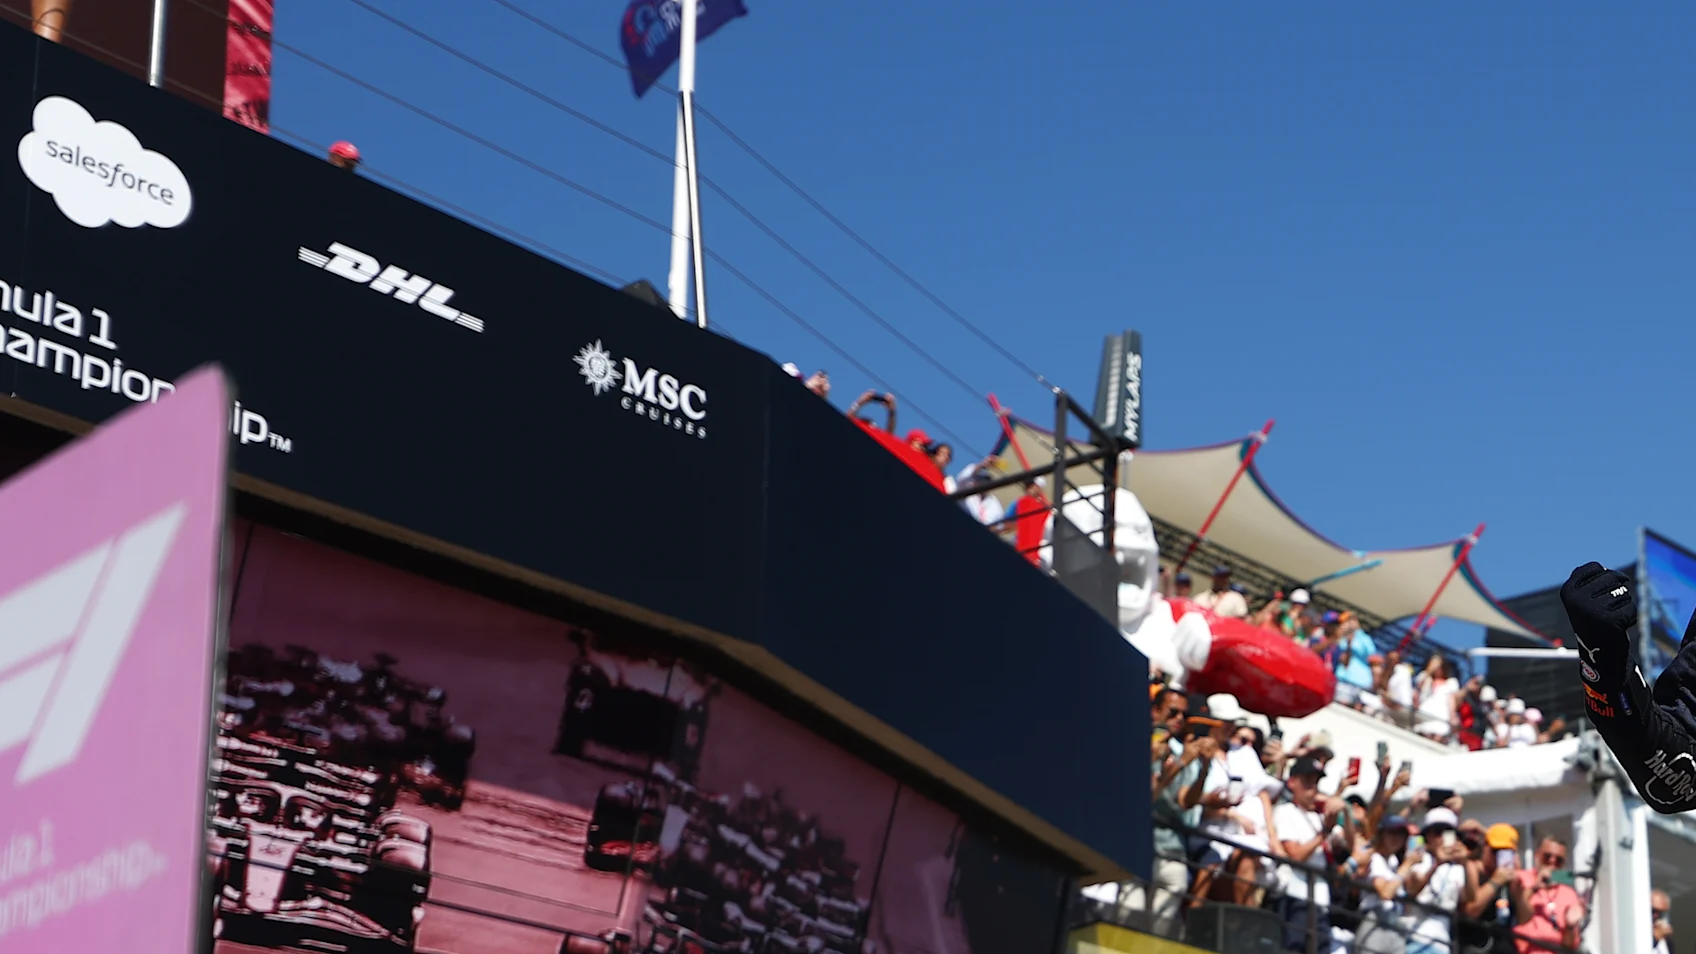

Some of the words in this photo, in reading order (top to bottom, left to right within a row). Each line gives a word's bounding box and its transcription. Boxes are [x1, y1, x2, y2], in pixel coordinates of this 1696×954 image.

[45, 138, 174, 205] salesforce
[0, 278, 83, 338] ula
[88, 307, 118, 350] 1
[324, 242, 462, 322] DHL
[620, 356, 708, 421] MSC
[620, 395, 708, 440] CRUISES
[1123, 351, 1142, 442] MYLAPS
